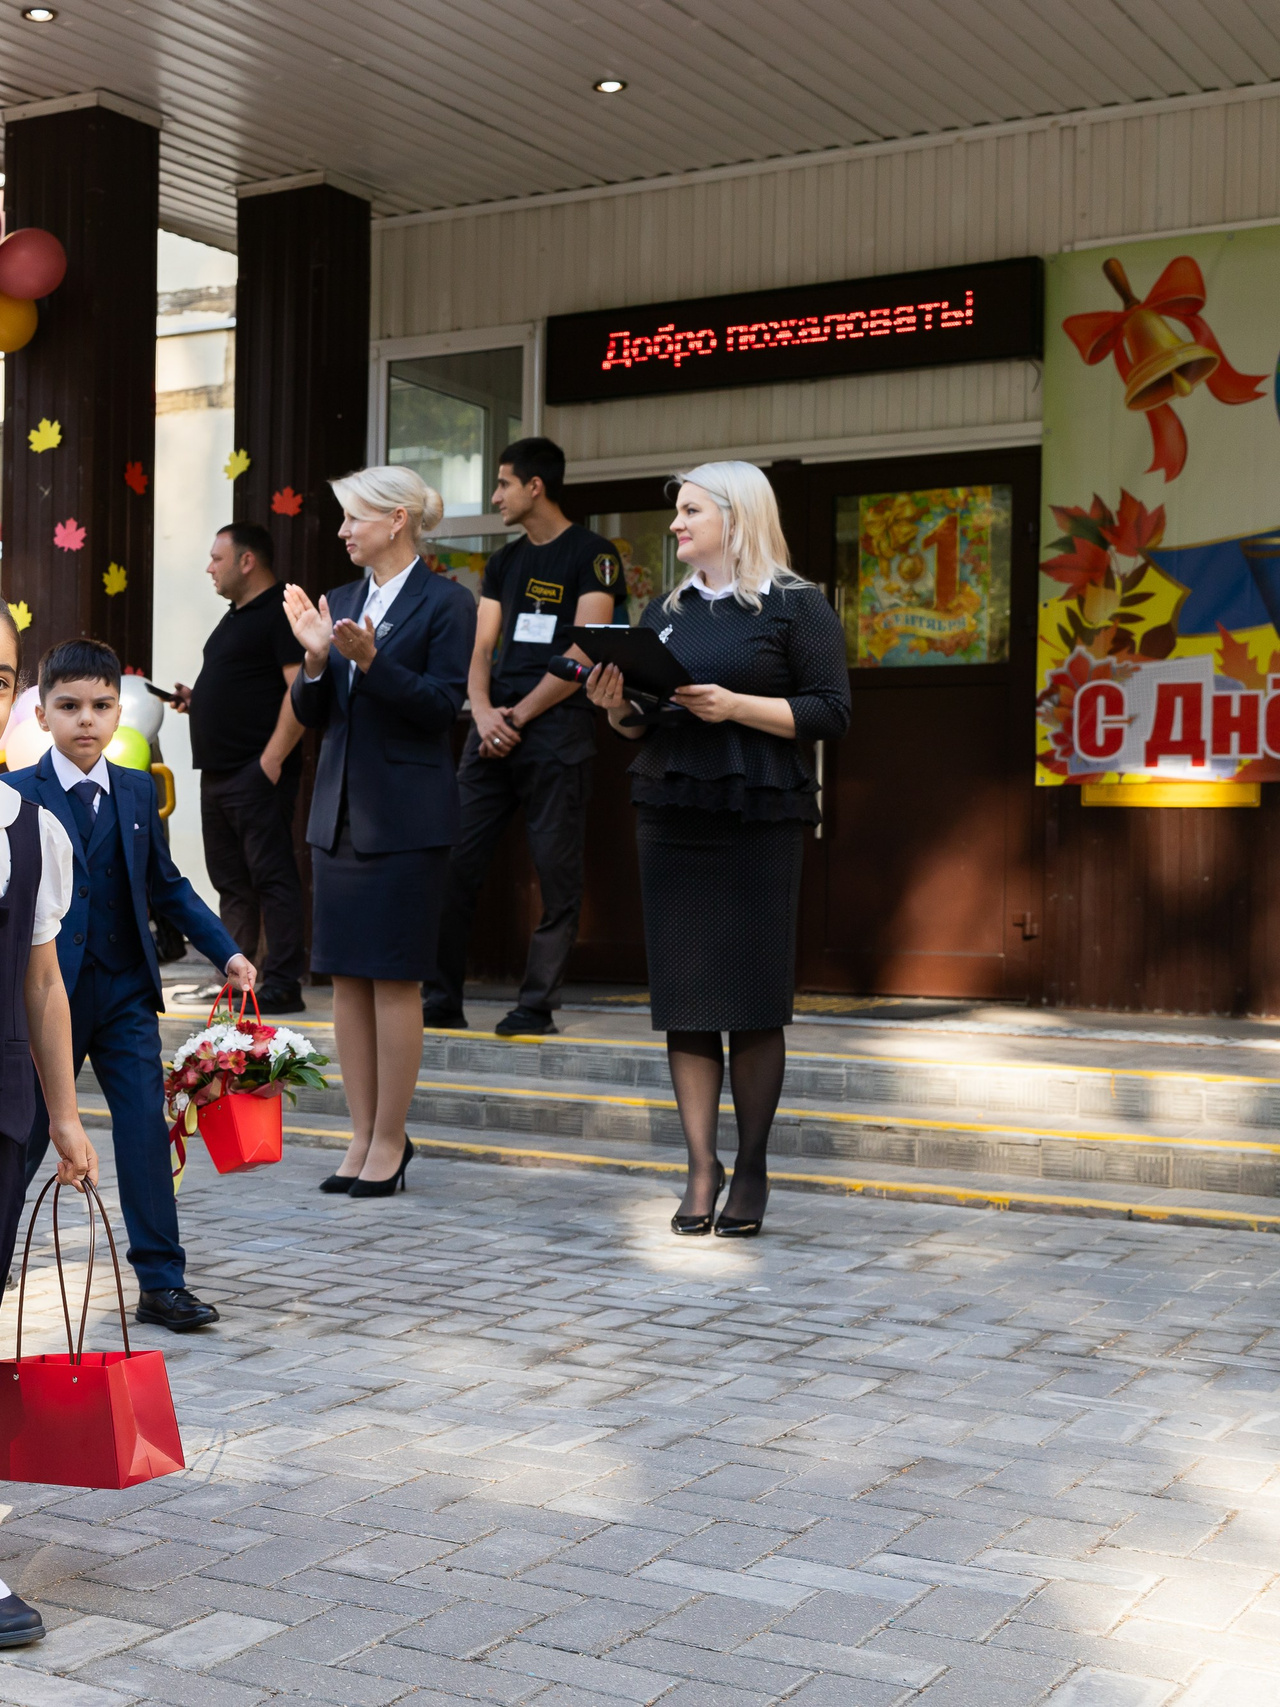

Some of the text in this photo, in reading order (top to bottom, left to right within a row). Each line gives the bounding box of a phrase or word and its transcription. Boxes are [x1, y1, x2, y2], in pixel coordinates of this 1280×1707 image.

[602, 290, 974, 370] Добро пожаловать!
[922, 514, 959, 611] 1
[1076, 681, 1125, 759] С
